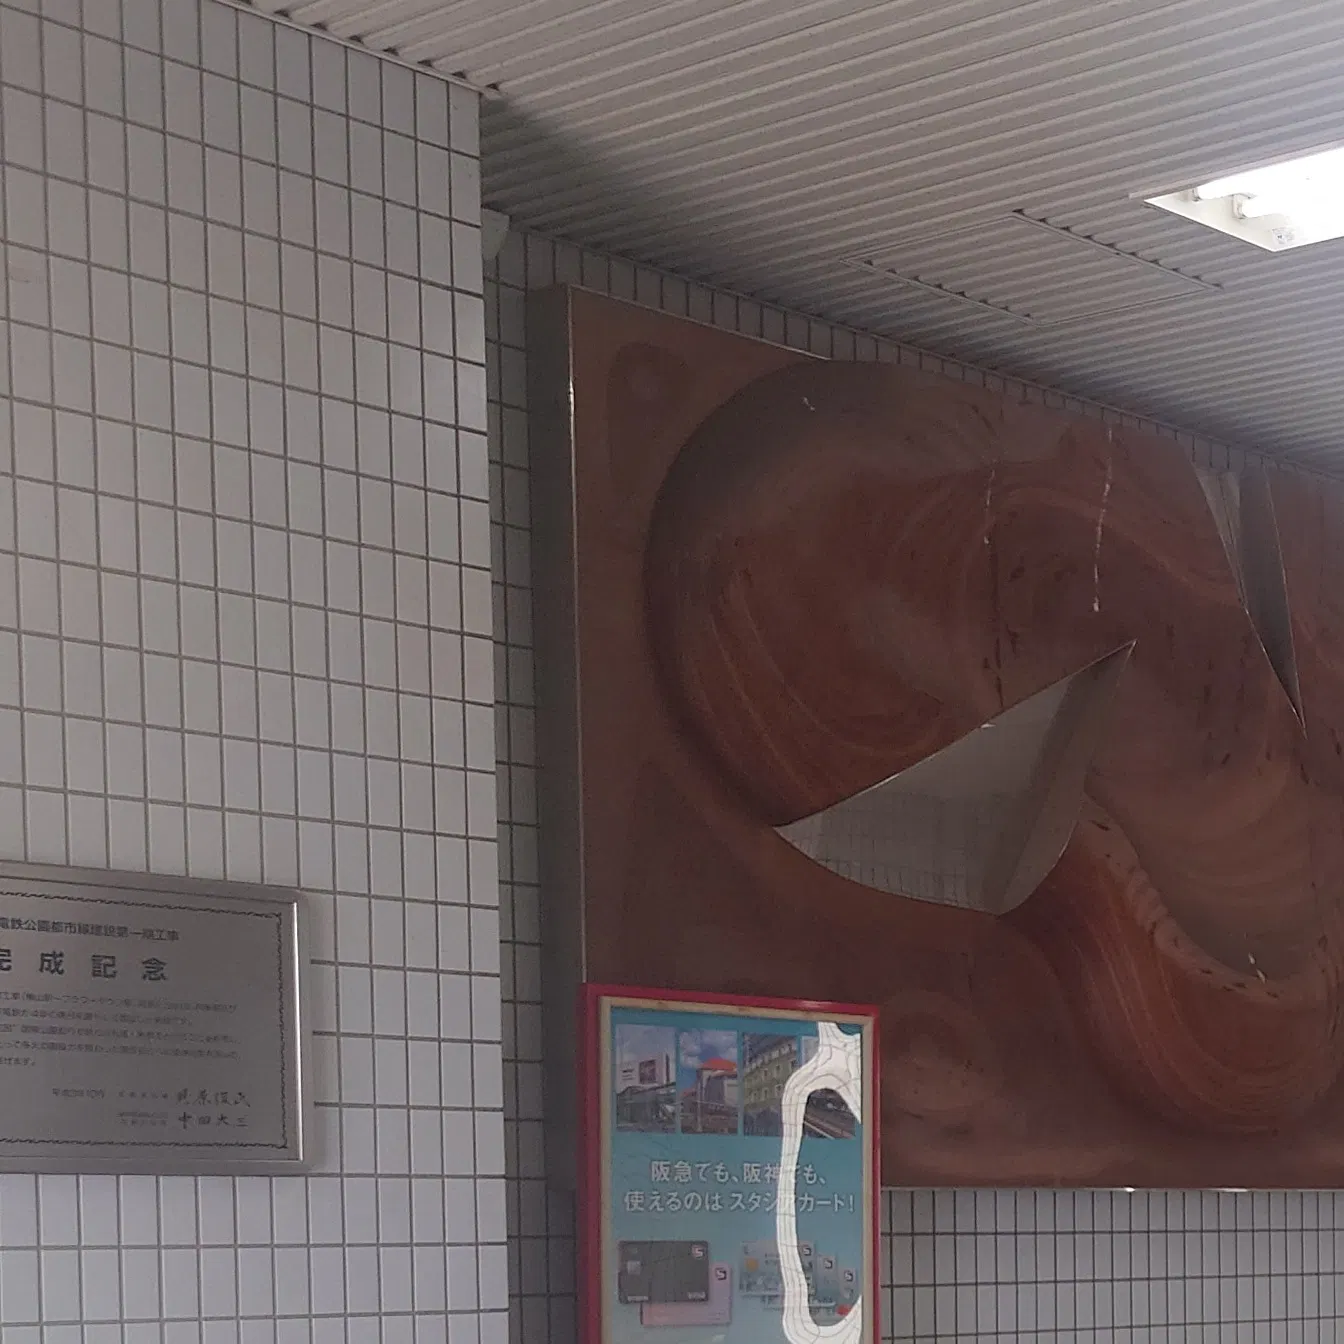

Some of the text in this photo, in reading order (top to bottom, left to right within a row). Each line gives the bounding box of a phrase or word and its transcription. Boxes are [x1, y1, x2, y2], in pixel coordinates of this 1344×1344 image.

[624, 1190, 856, 1213] 使えるのは スタシカード!
